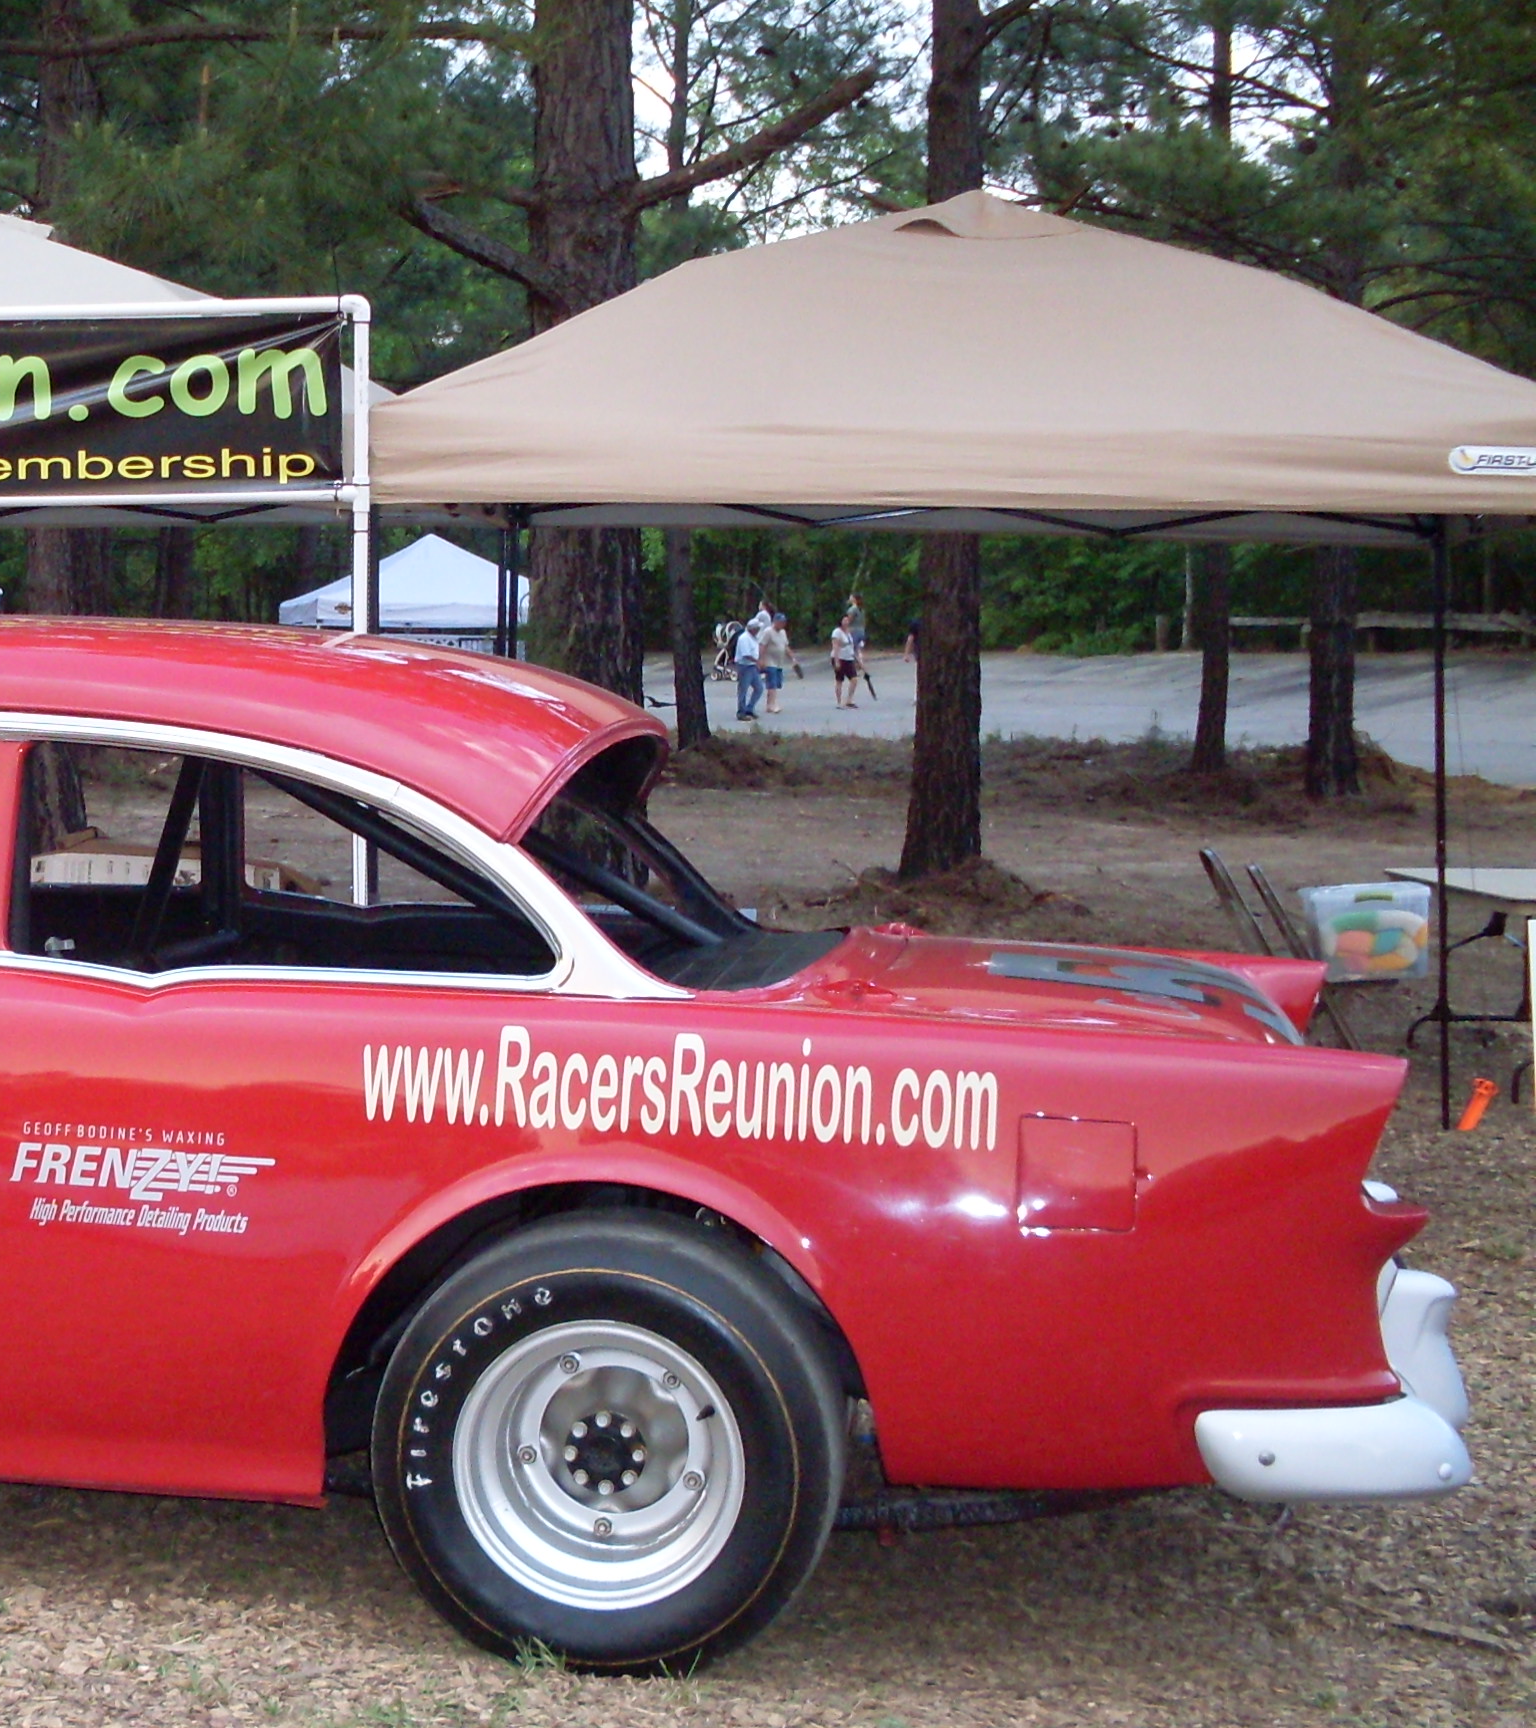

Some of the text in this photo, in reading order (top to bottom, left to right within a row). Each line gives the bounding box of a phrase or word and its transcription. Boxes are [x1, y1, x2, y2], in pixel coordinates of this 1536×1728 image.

[362, 1024, 999, 1151] www.RacersReunion.com
[23, 1121, 226, 1147] GEOFF BODINE'S WAXING
[30, 1197, 249, 1236] High Performance Detailing Products
